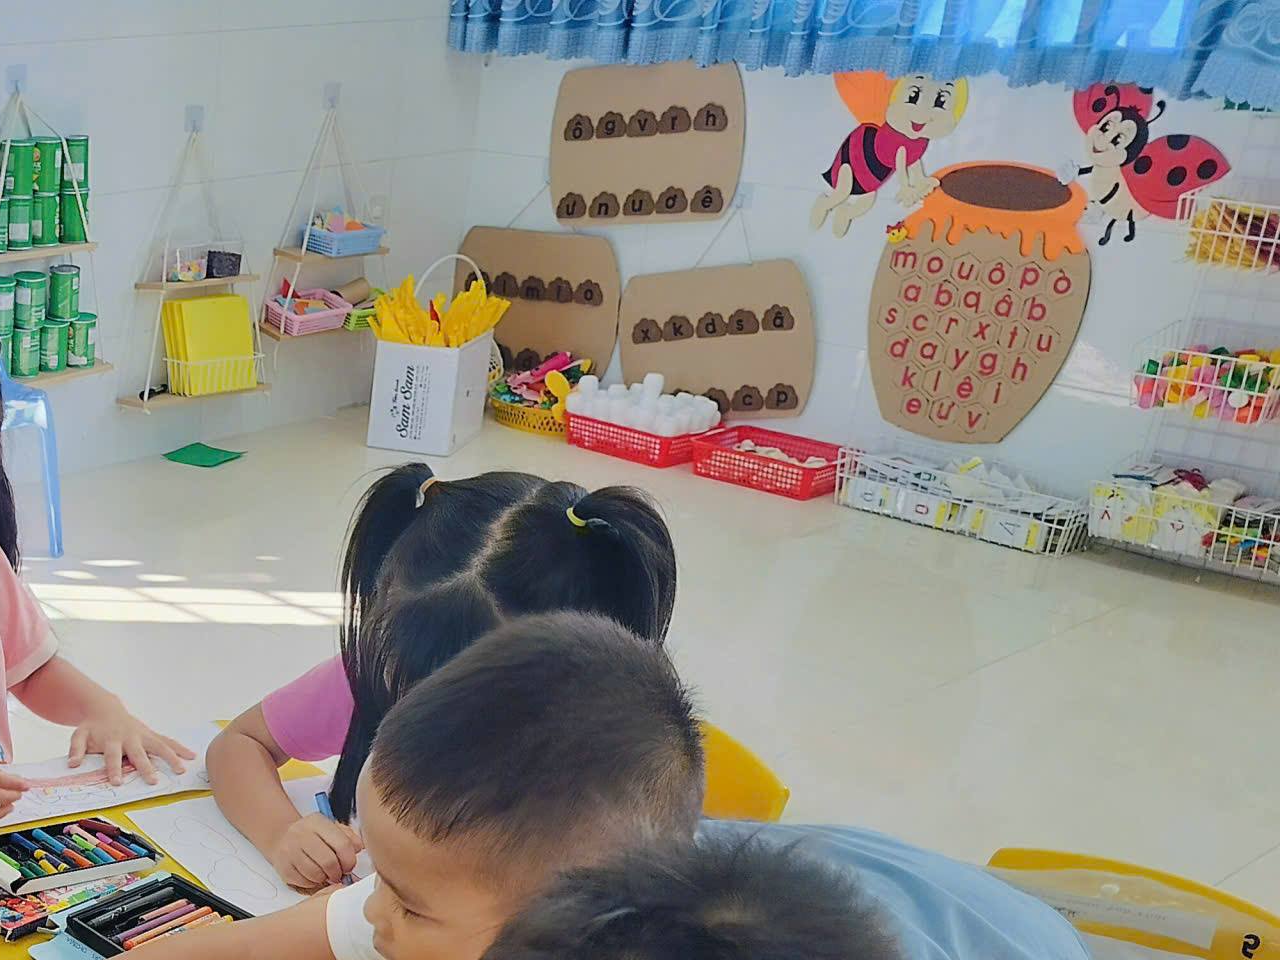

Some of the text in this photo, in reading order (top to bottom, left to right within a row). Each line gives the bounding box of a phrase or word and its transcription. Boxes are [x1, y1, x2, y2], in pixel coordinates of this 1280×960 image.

[638, 118, 648, 132] v
[705, 110, 716, 127] h
[894, 251, 917, 269] m
[1019, 267, 1040, 289] p
[934, 283, 953, 307] b
[1028, 297, 1046, 321] b
[945, 317, 958, 334] r
[973, 321, 990, 340] x
[901, 366, 917, 388] k
[953, 348, 969, 370] y
[978, 353, 998, 376] g
[1011, 357, 1028, 381] h
[401, 365, 415, 400] Sam
[396, 404, 410, 438] Sam
[968, 411, 983, 428] v
